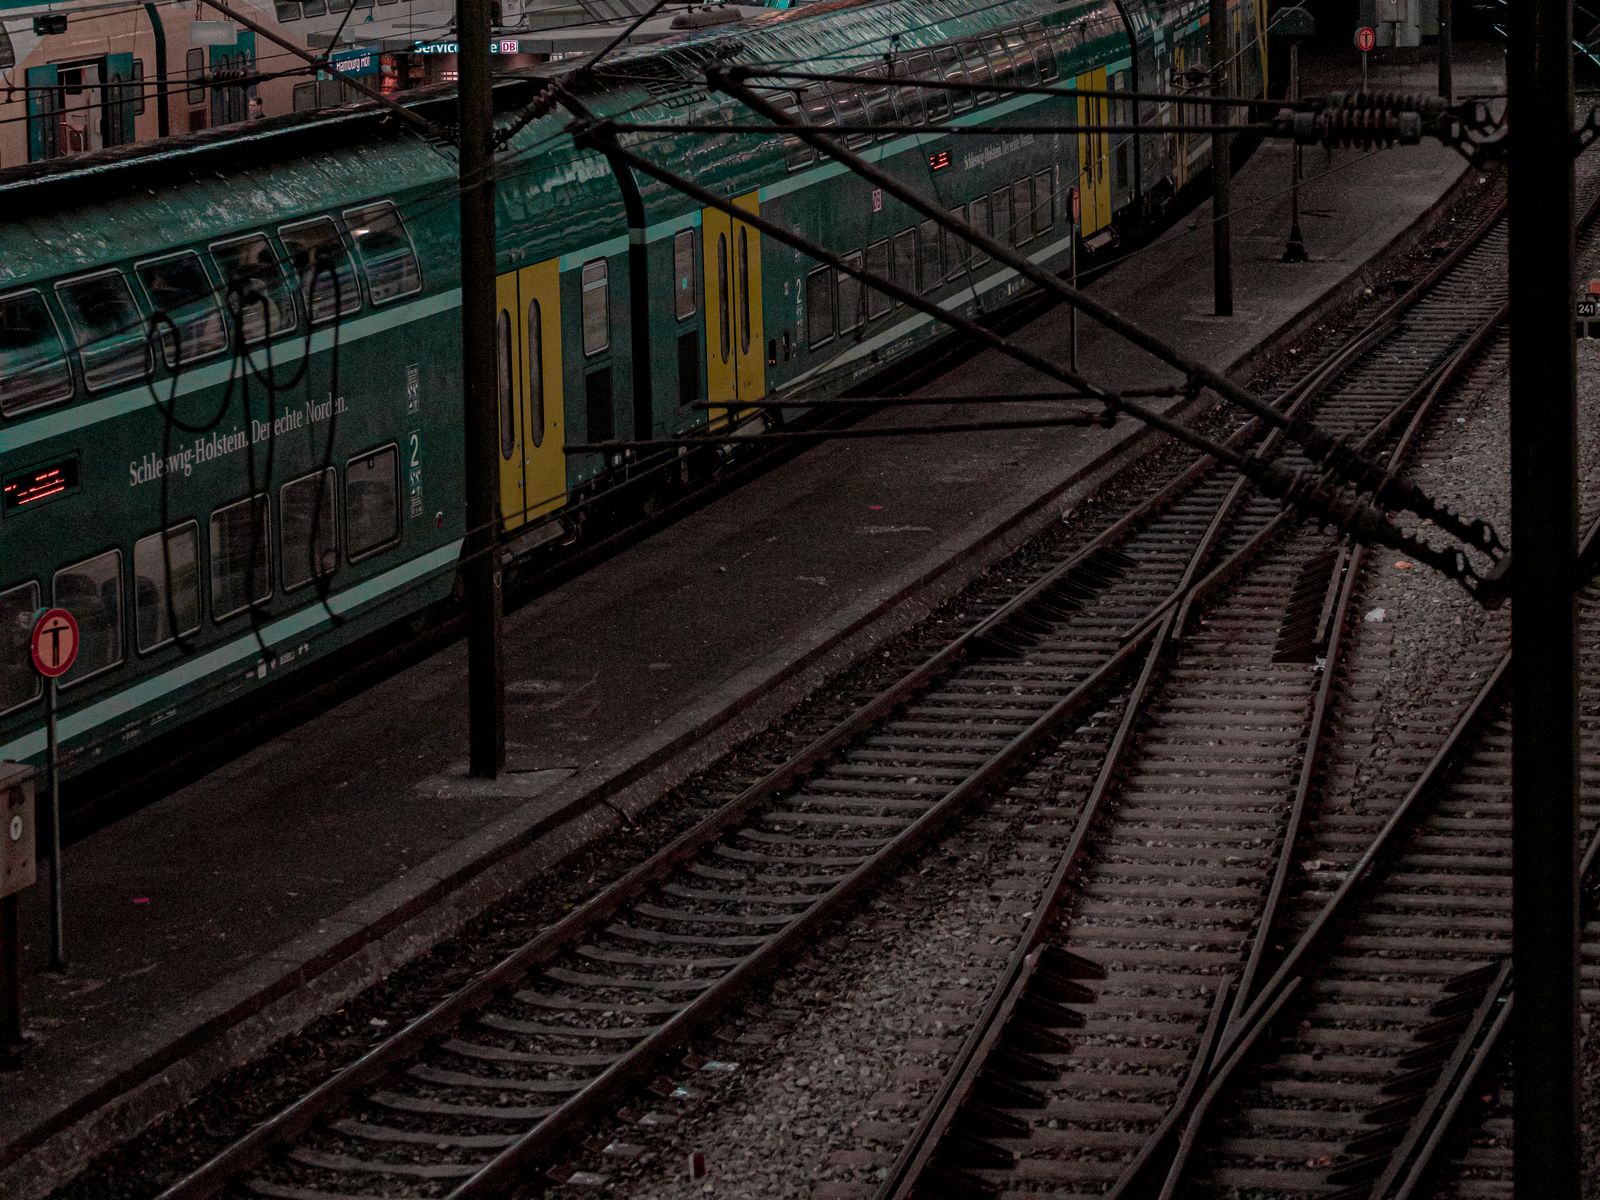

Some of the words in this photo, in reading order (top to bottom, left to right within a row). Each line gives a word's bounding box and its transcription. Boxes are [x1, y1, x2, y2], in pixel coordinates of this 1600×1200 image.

[503, 41, 516, 52] DB
[796, 278, 802, 304] 2
[1578, 303, 1594, 314] 241
[251, 420, 271, 445] Der
[274, 406, 303, 434] echte
[410, 433, 419, 468] 2
